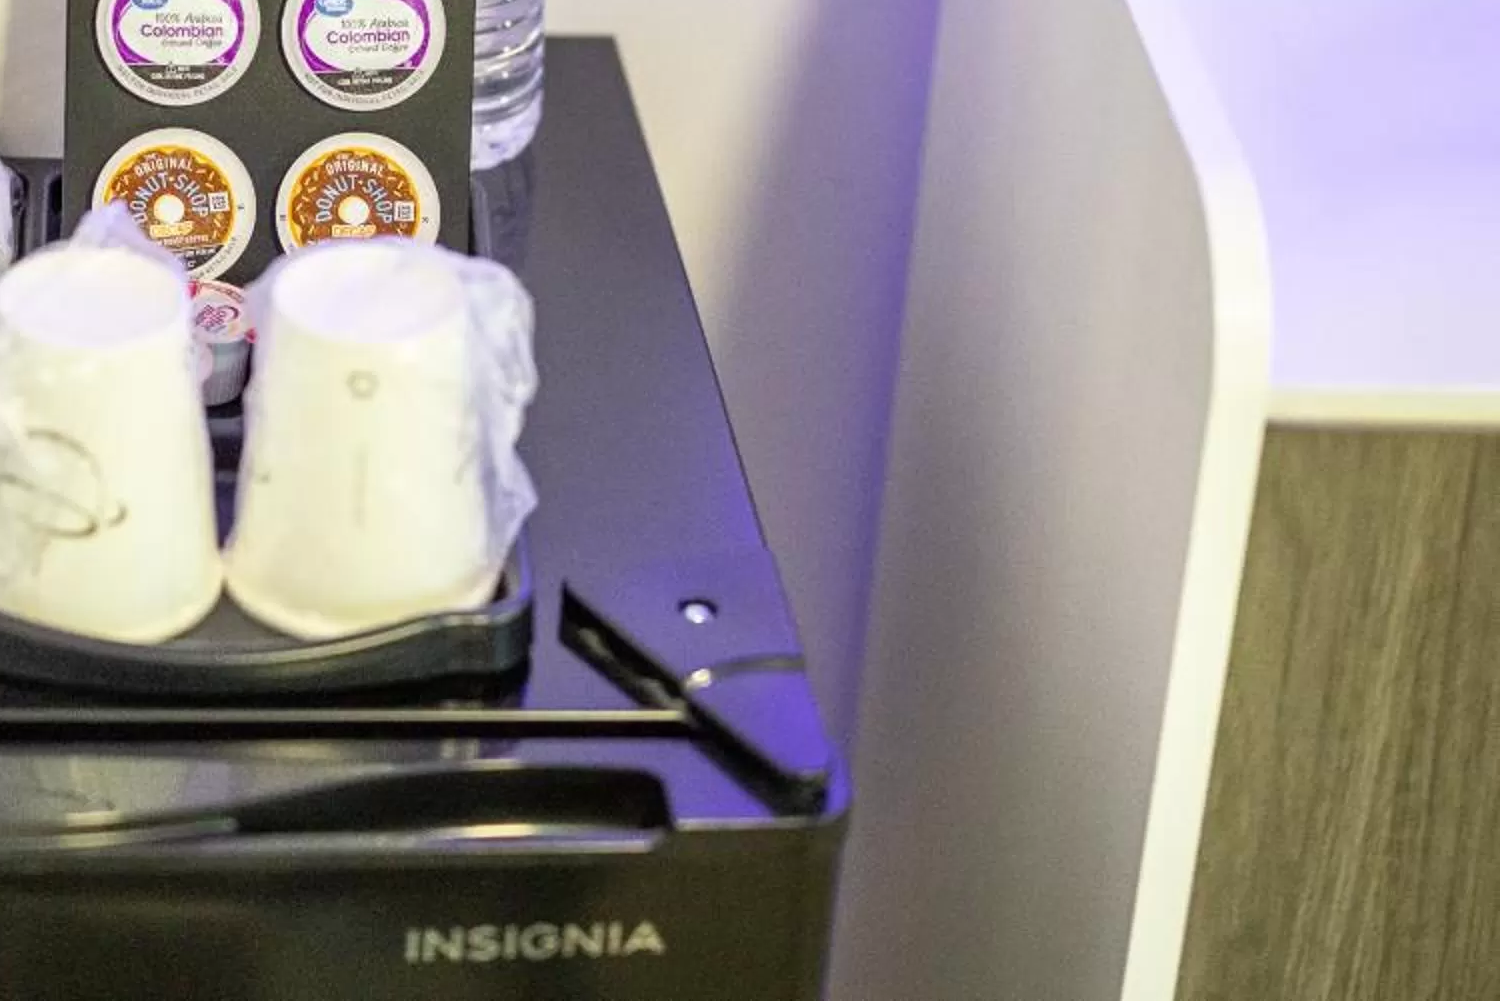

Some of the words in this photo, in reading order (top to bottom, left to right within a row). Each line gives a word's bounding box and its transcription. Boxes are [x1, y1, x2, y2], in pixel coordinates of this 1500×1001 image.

[140, 23, 223, 37] Colombian
[327, 29, 410, 44] Colombian
[134, 157, 193, 177] ORIGINAL
[326, 159, 384, 178] ORIGINAL
[404, 920, 667, 964] INSIGNIA
